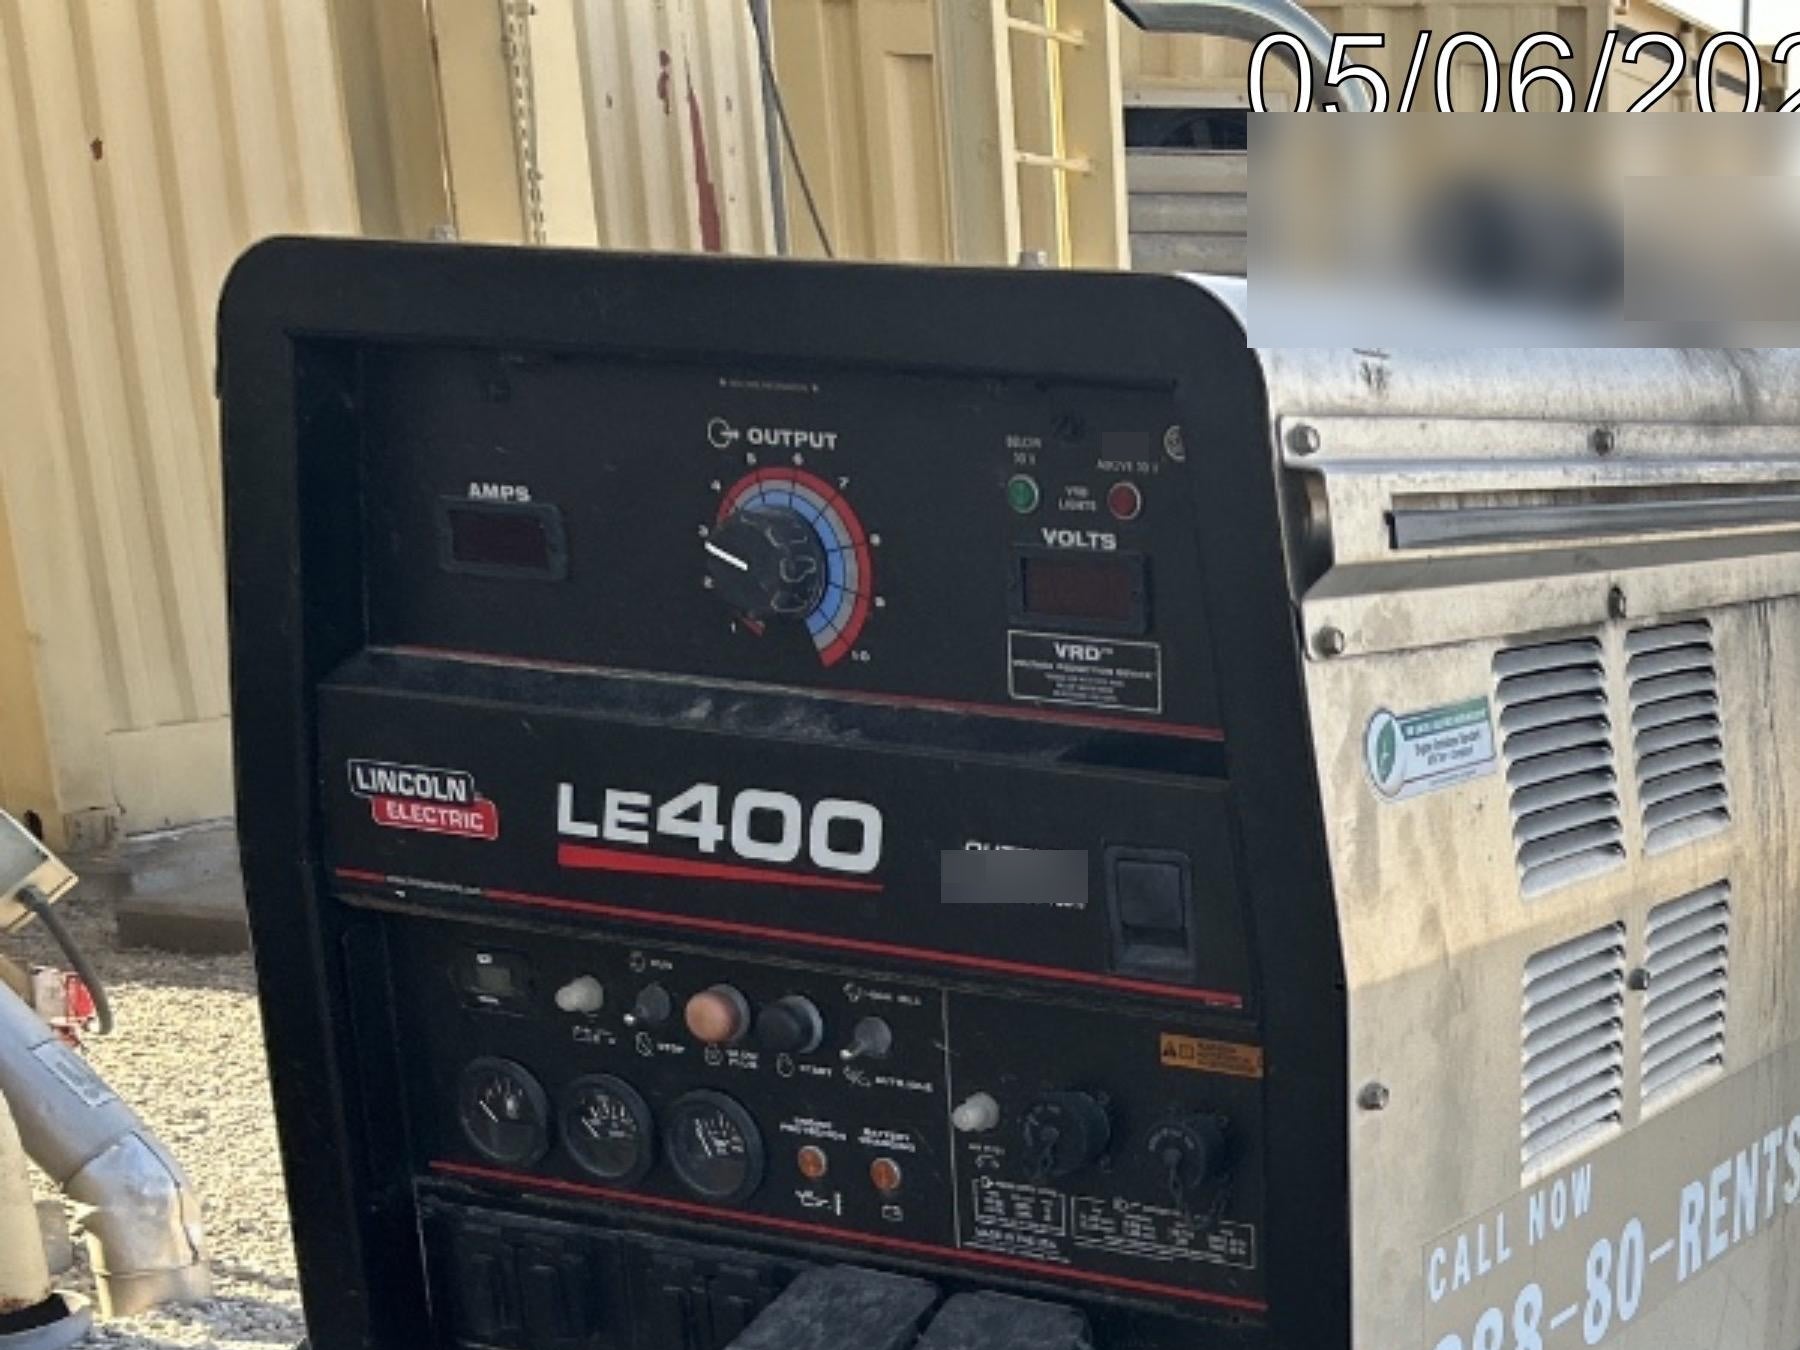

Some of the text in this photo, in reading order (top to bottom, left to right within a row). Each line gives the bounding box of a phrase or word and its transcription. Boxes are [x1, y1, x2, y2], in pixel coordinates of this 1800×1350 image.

[747, 427, 838, 450] OUTPUT
[468, 483, 532, 502] AMPS
[1041, 527, 1117, 551] VOLTS
[354, 765, 467, 802] LINCOLN
[385, 802, 485, 832] ELECTRIC
[557, 782, 883, 874] LE400
[1428, 1163, 1593, 1303] CALL NOW
